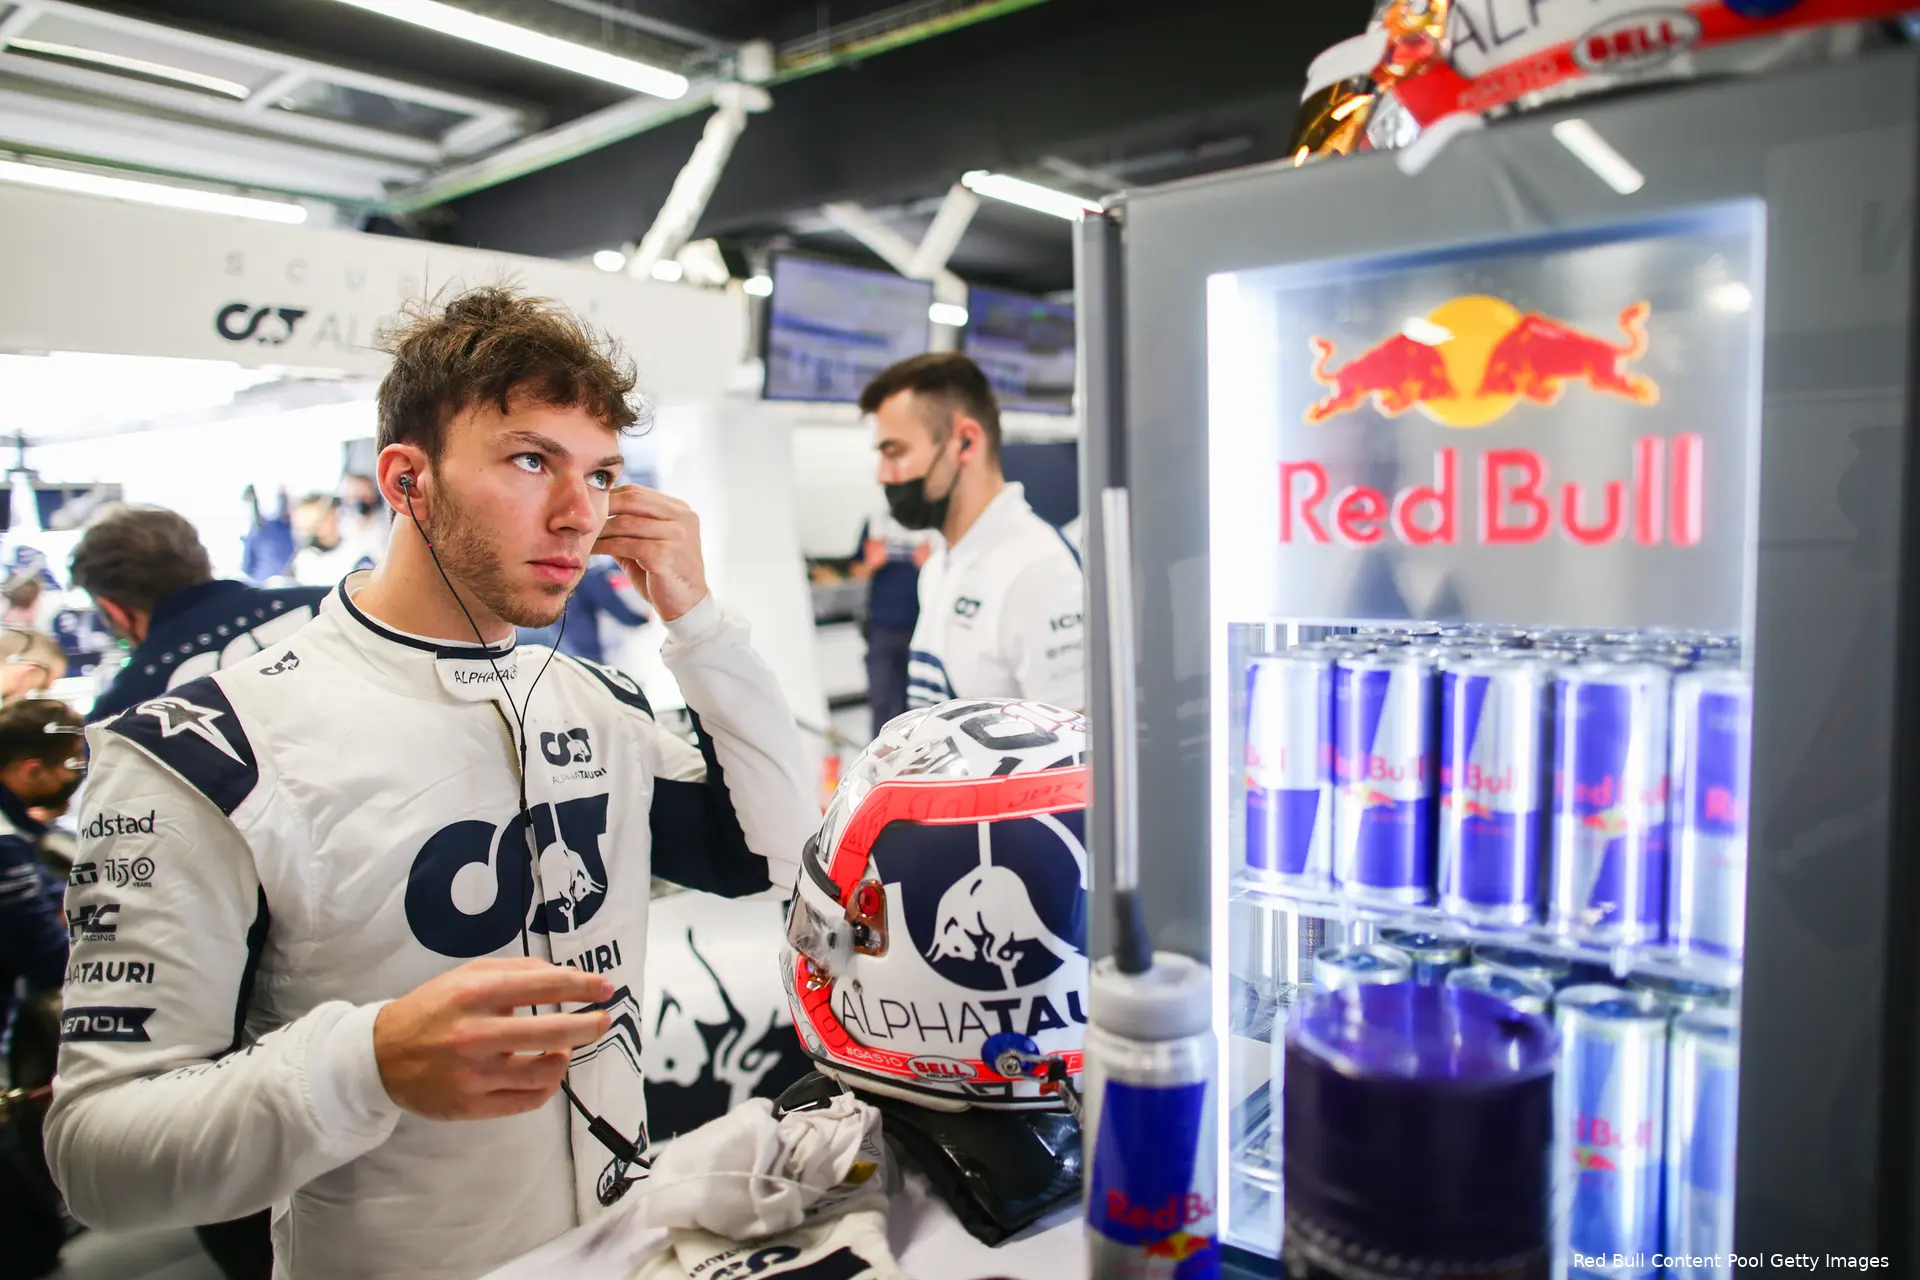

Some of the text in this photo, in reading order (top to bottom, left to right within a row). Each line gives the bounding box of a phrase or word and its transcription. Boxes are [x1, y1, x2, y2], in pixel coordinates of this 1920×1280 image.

[1278, 434, 1704, 546] Red Bull
[912, 1060, 968, 1077] BELL
[1107, 1187, 1179, 1231] Red
